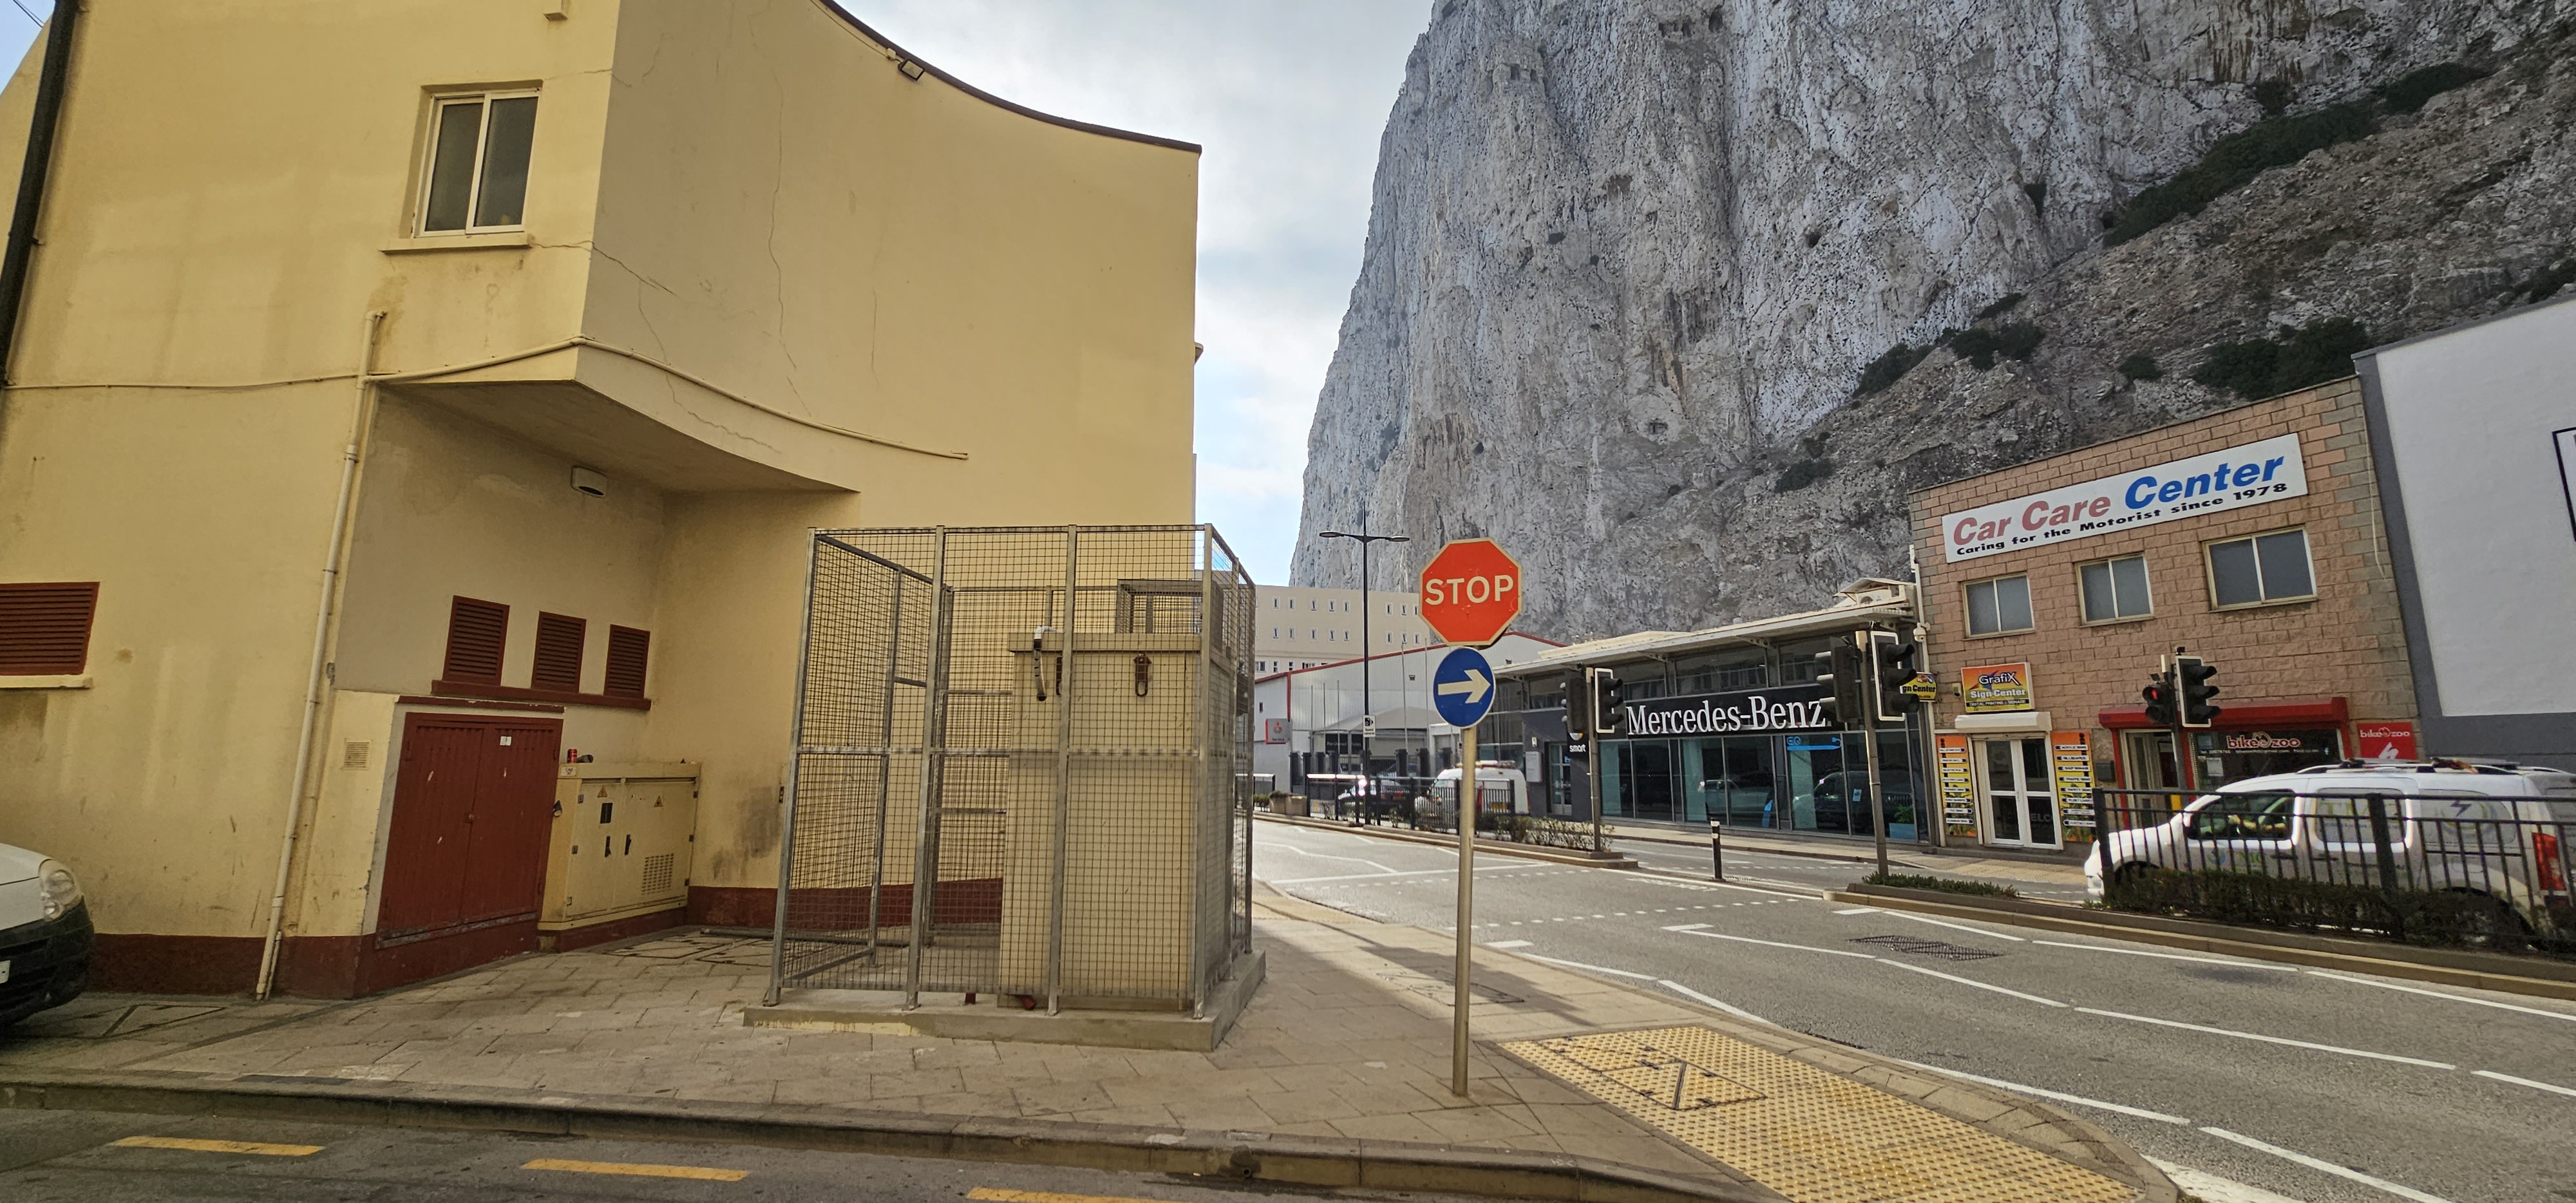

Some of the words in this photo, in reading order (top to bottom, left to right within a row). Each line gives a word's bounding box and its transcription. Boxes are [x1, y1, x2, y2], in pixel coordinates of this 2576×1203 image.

[1953, 516, 2012, 545] Car
[2022, 497, 2111, 531] Care
[2125, 456, 2284, 509] Center
[1956, 541, 2005, 555] Caring
[2012, 535, 2036, 545] for
[2043, 527, 2071, 539] the
[2079, 509, 2161, 531] Motorist
[2171, 498, 2223, 513] since
[2233, 483, 2287, 500] 1978
[1425, 574, 1514, 605] STOP
[1979, 672, 2021, 685] GrafiX
[1970, 689, 1992, 699] Sign
[1994, 688, 2025, 697] Center
[1625, 696, 1826, 735] Mercedes-Benz
[2360, 729, 2382, 737] bike
[1569, 744, 1586, 752] smart
[2226, 735, 2259, 748] bike
[2271, 739, 2300, 747] zoo
